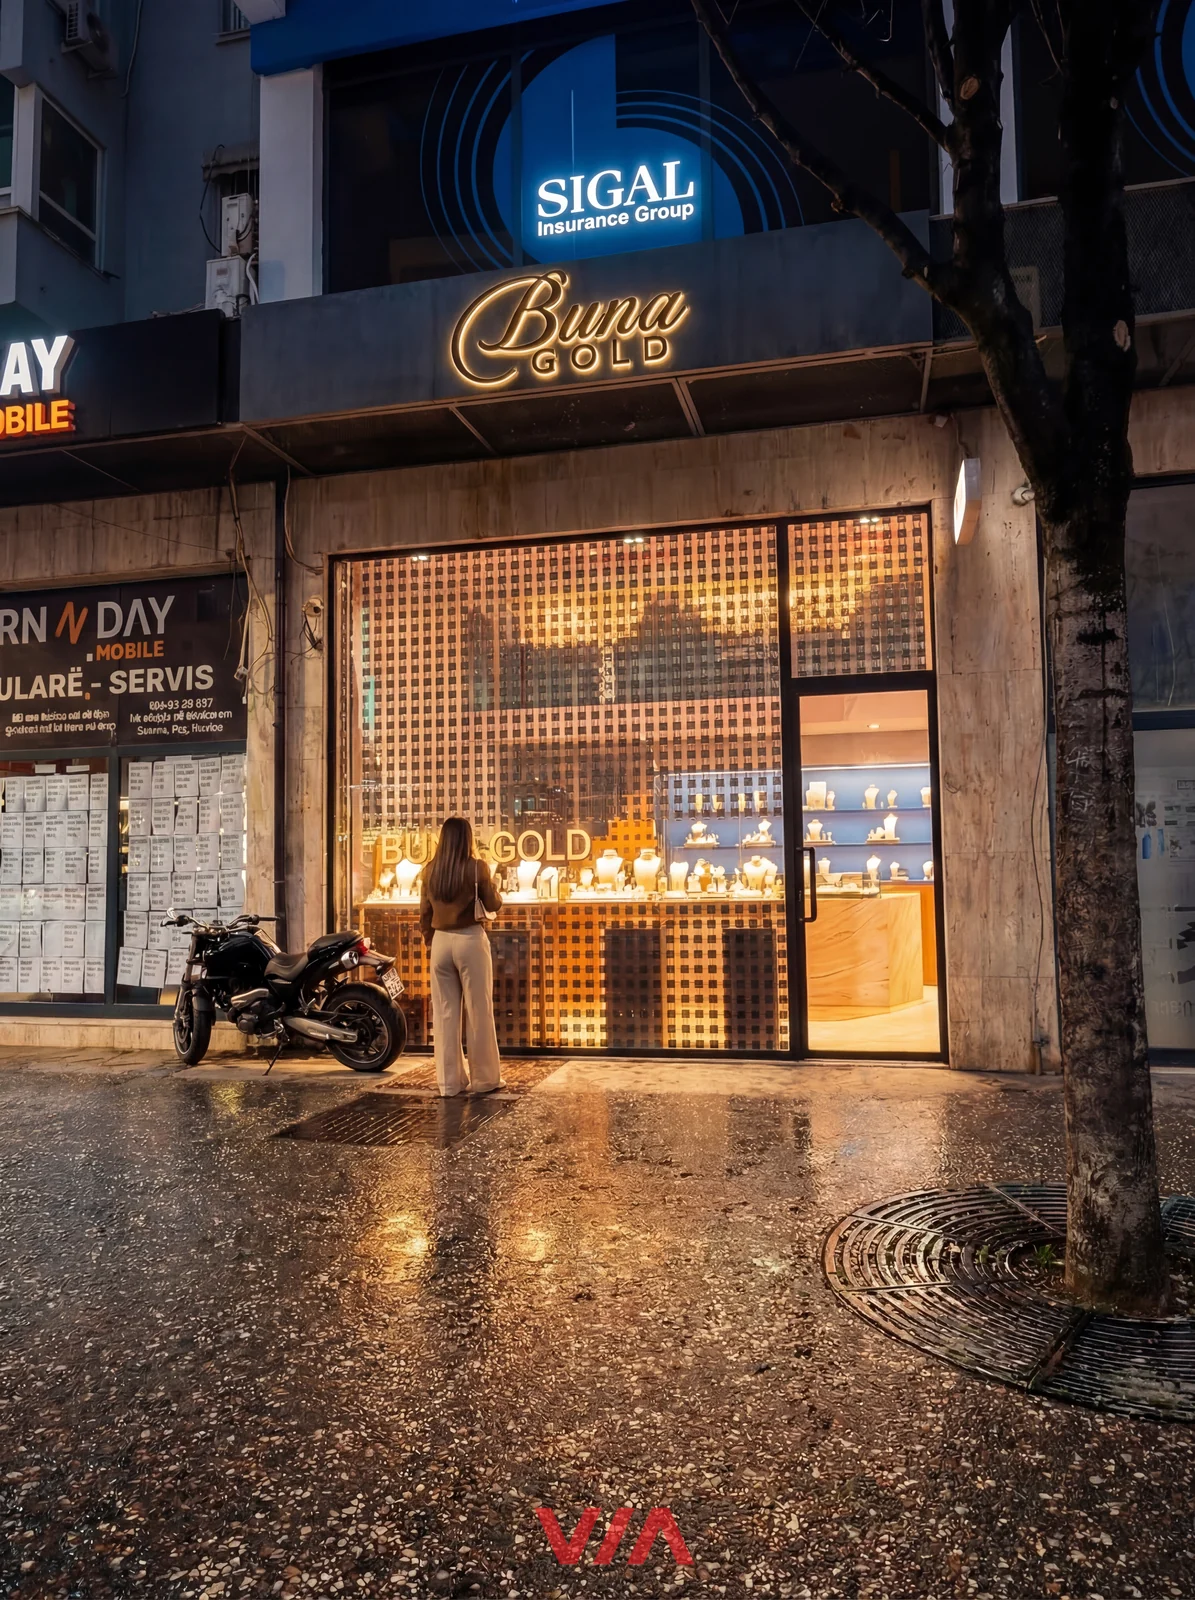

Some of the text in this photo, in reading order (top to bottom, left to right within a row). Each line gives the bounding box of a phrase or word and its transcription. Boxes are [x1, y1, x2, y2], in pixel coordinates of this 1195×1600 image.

[537, 160, 695, 218] SIGAL
[537, 203, 695, 236] Insurance Group
[451, 269, 690, 387] Buna
[0, 335, 75, 397] AY
[531, 335, 671, 375] GOLD
[0, 399, 75, 438] BILE
[0, 606, 47, 645] RN
[97, 595, 175, 639] DAY
[109, 665, 214, 694] SERVIS
[381, 829, 592, 865] BU GOLD
